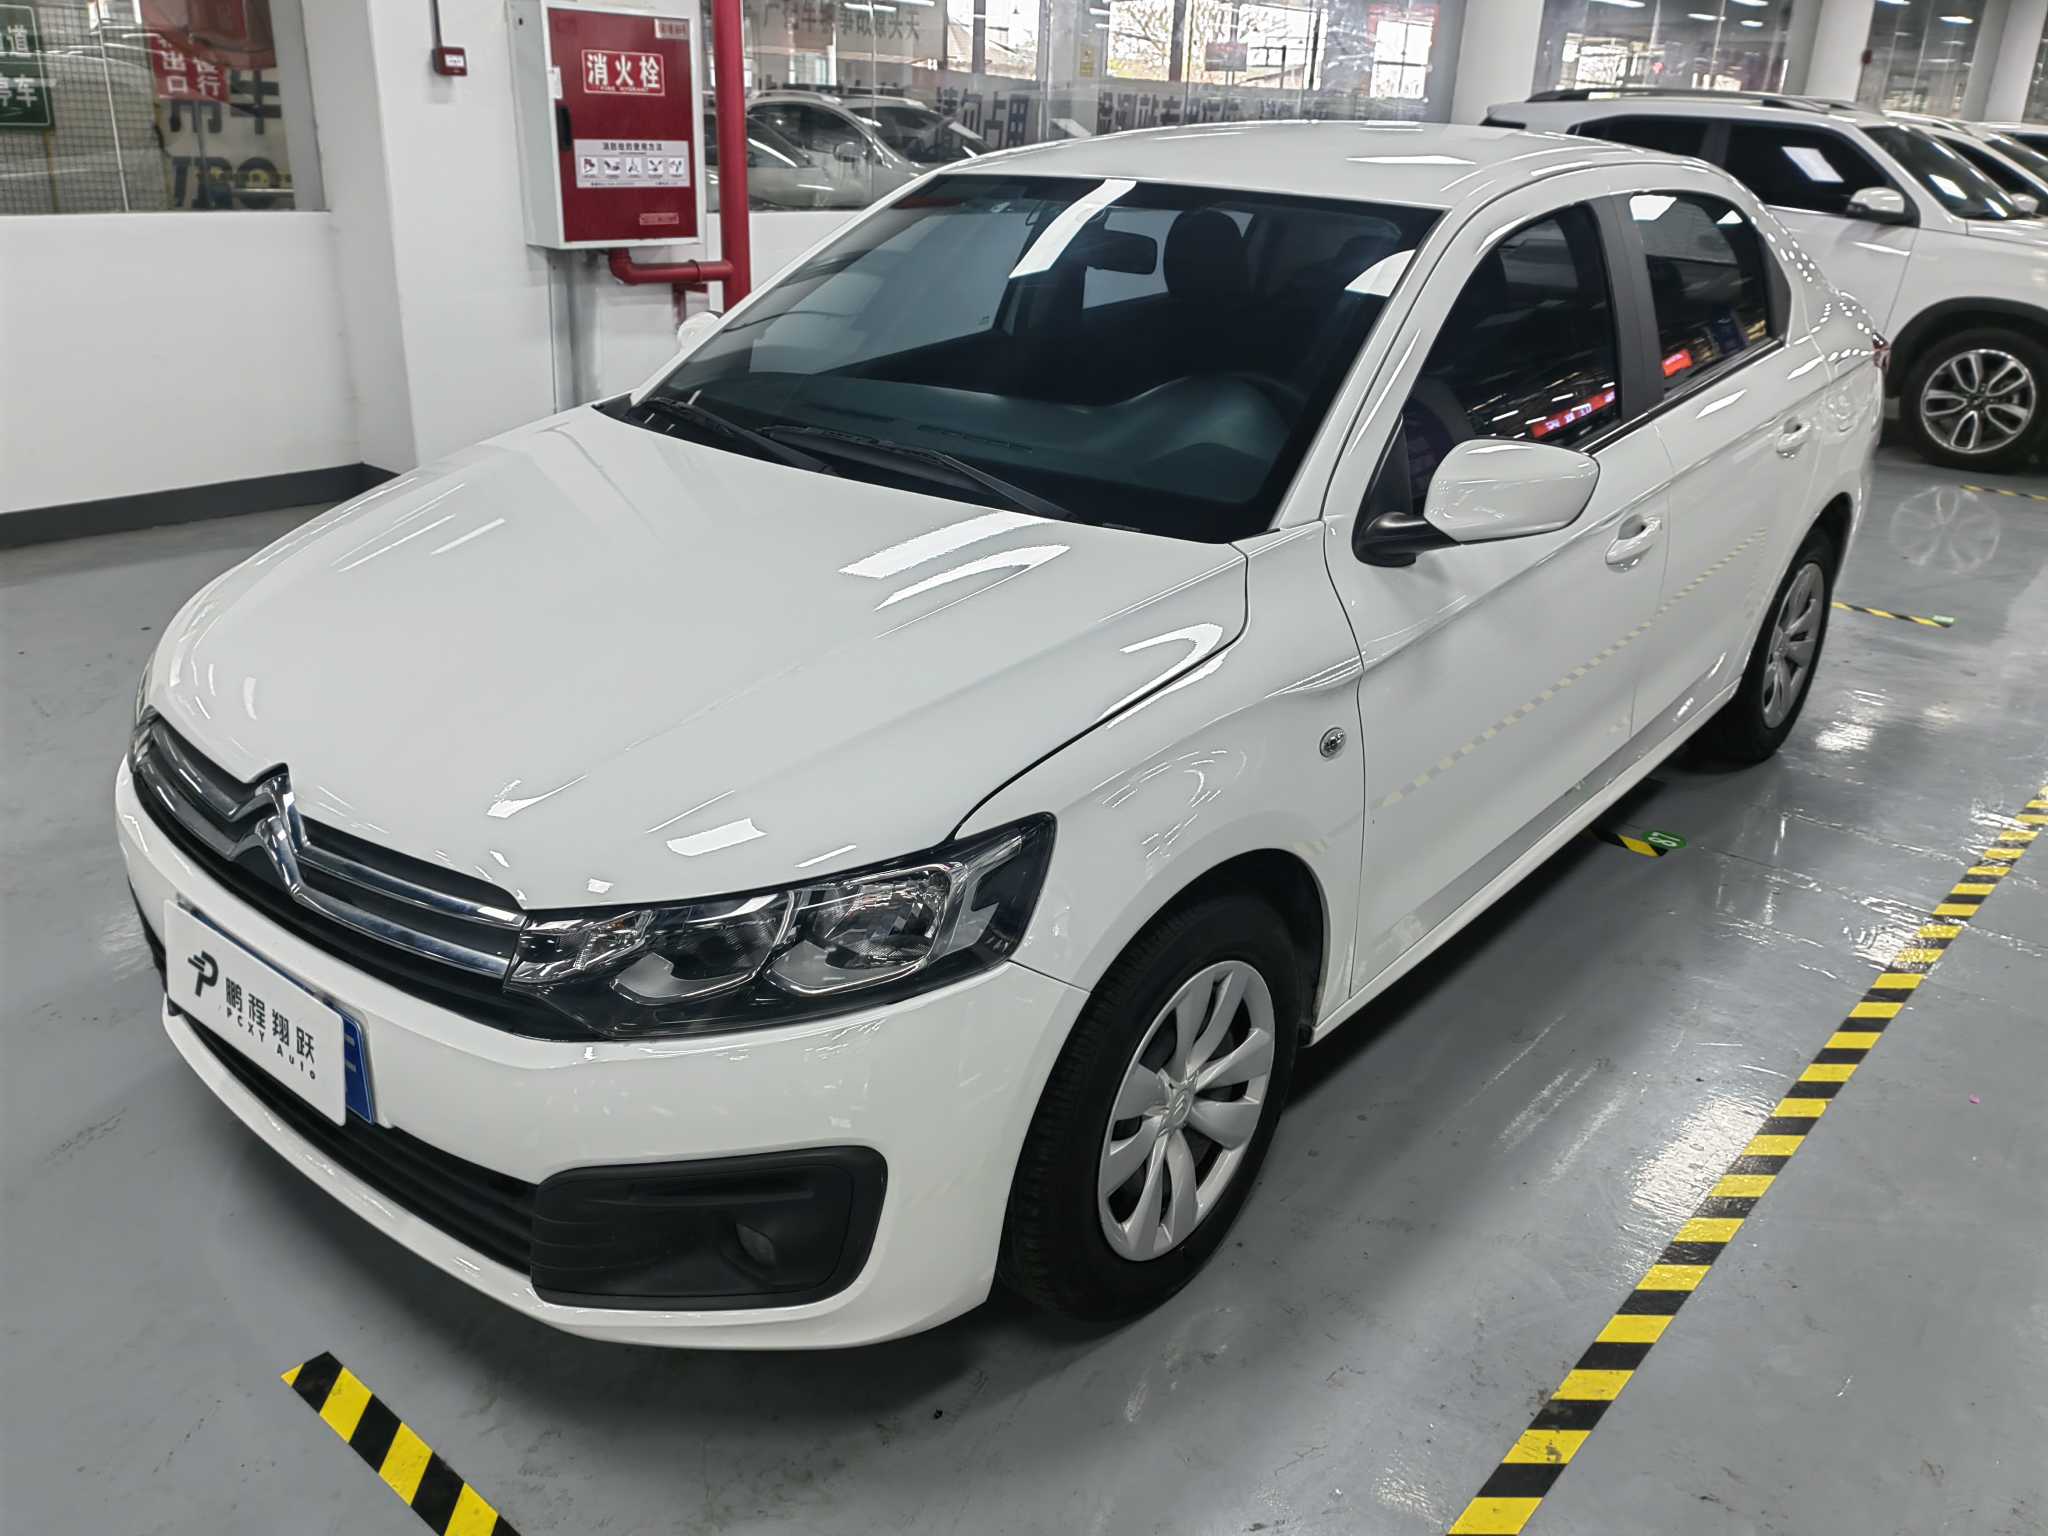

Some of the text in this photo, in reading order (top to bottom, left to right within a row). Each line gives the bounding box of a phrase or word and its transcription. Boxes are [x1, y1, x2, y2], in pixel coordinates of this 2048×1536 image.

[0, 24, 32, 58] 道
[586, 53, 661, 89] 消火栓
[225, 977, 314, 1064] 鹏程翔跃
[227, 1007, 264, 1042] PCXY
